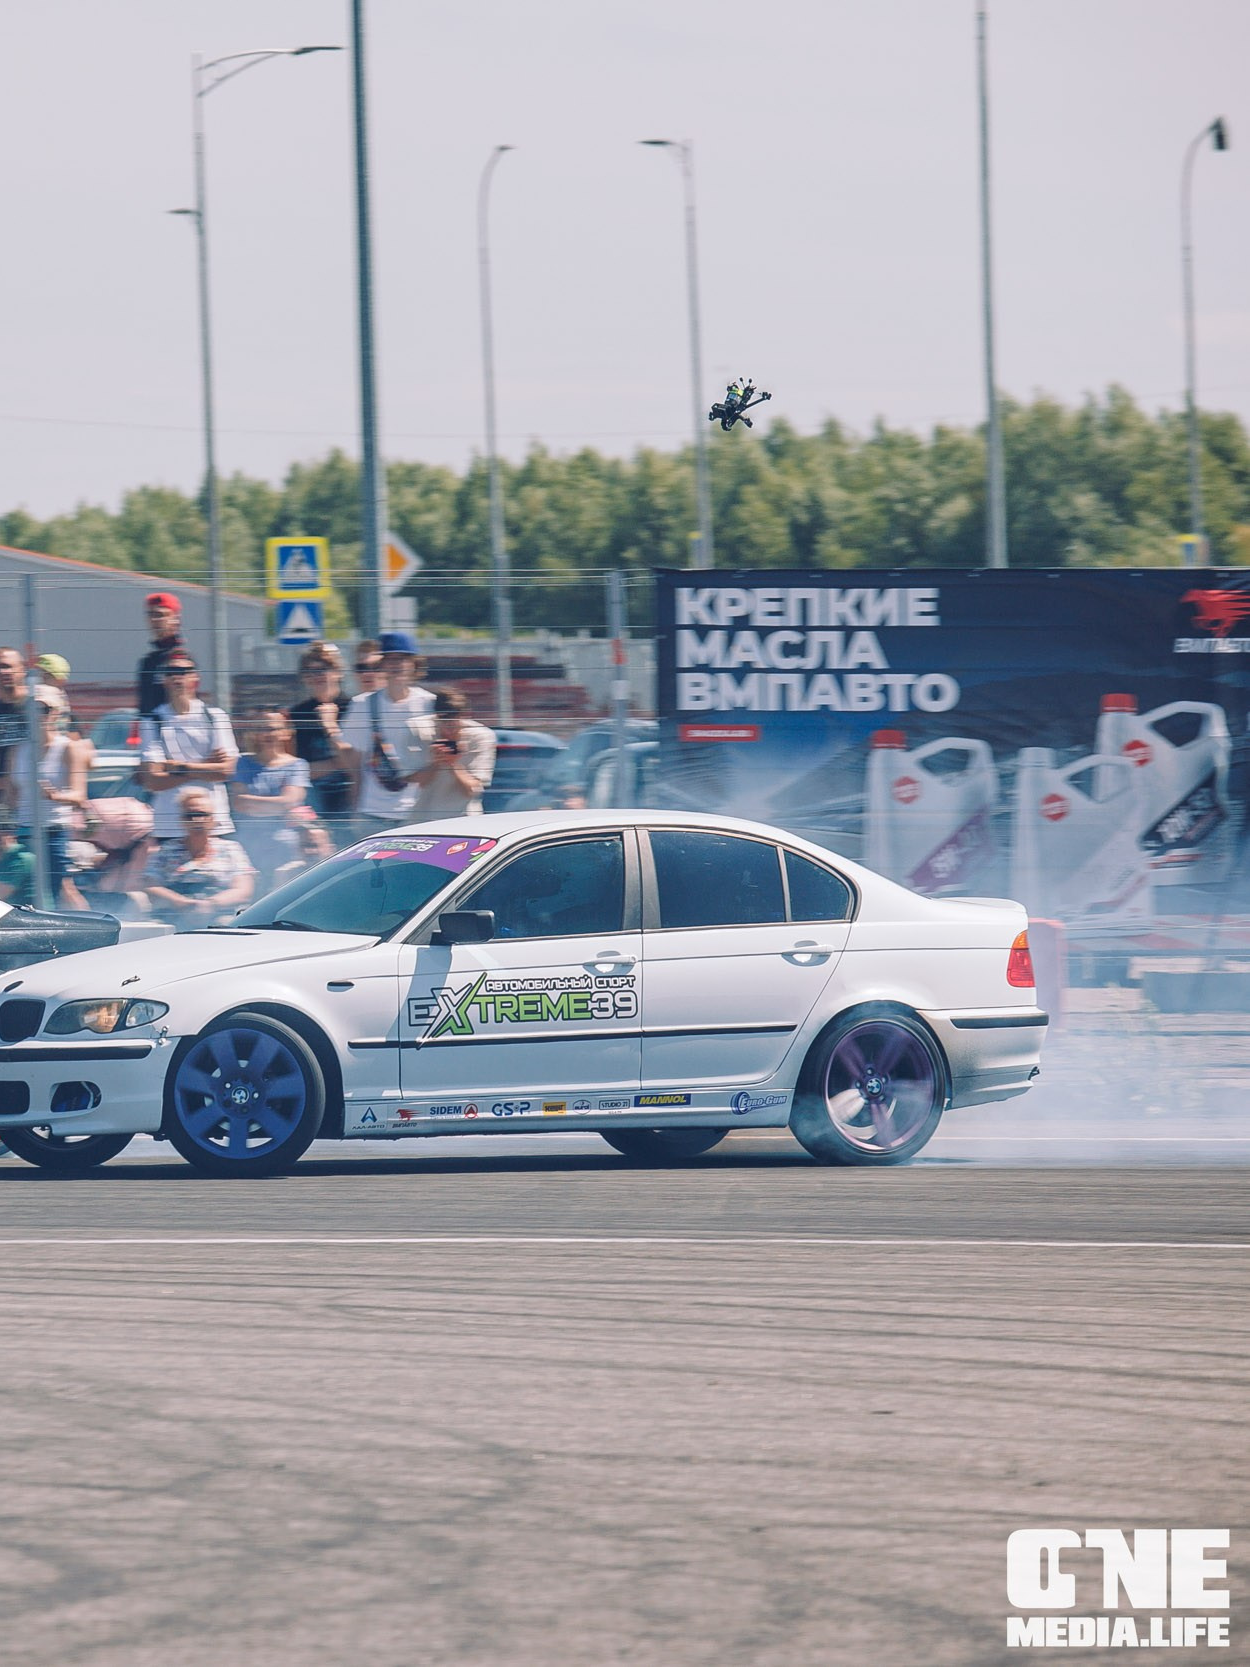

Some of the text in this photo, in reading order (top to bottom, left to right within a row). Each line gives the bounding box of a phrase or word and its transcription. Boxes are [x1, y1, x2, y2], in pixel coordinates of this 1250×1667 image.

[675, 588, 941, 627] КРЕПКИЕ
[676, 629, 890, 669] МАСЛА
[676, 673, 960, 712] ВМПАВТО
[485, 975, 635, 992] АВТОМОБИЛЬНЫЙ СПОРТ
[408, 972, 638, 1050] EXTREME39
[430, 1106, 462, 1115] SIDEM
[639, 1095, 688, 1105] MANNOL
